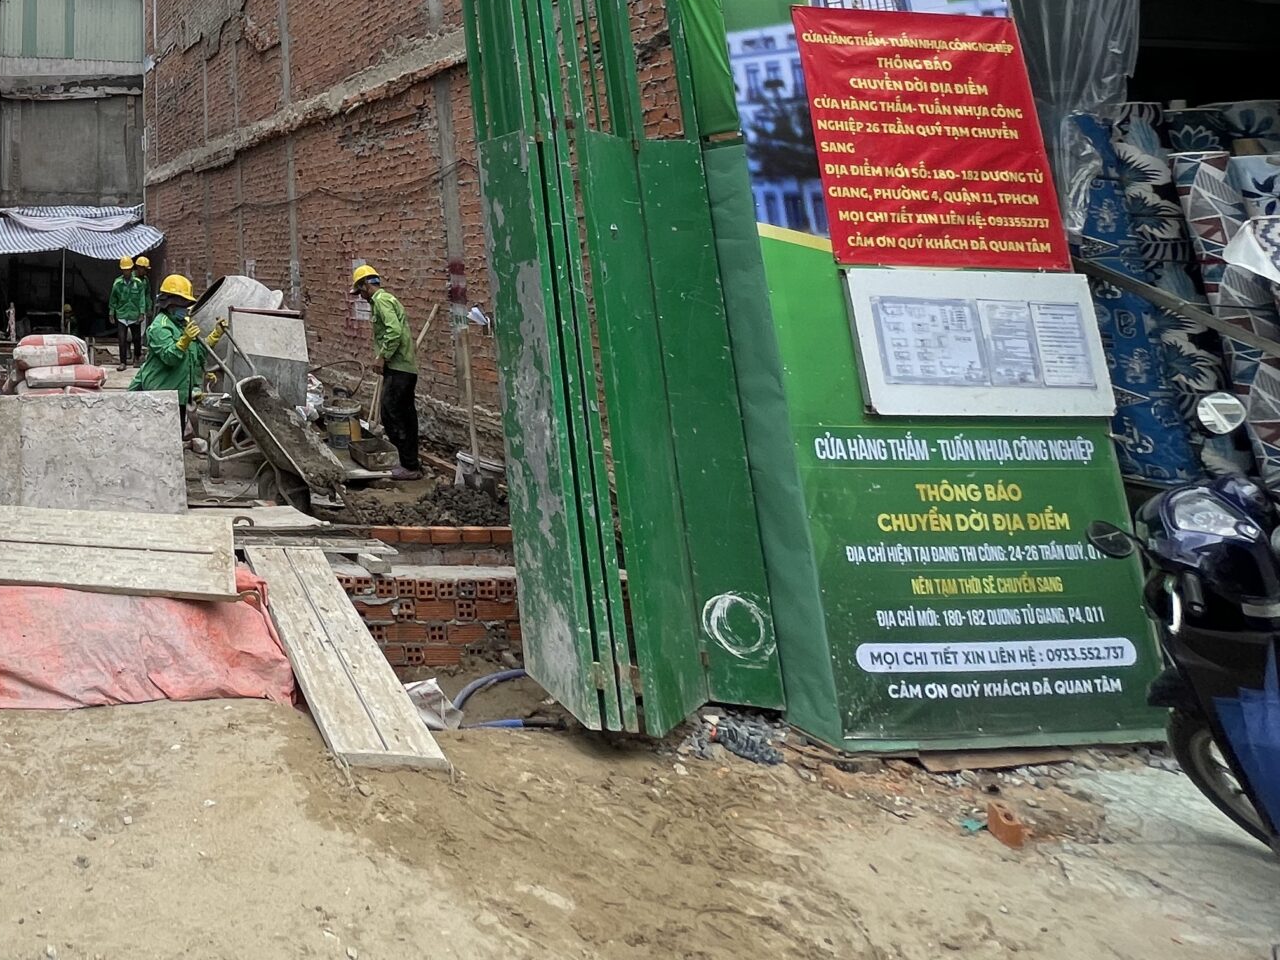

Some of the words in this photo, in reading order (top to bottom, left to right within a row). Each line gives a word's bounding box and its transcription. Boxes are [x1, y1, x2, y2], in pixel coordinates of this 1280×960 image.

[876, 54, 923, 71] THÔNG
[923, 56, 953, 72] BÁO
[849, 72, 903, 92] CHUYỂN
[930, 82, 953, 97] ĐỊA
[954, 76, 989, 96] ĐIỂM
[841, 95, 878, 111] HÀNG
[990, 103, 1023, 119] CÔNG
[865, 123, 880, 133] 26
[881, 117, 915, 135] TRẦN
[820, 141, 856, 154] SANG
[943, 188, 981, 206] QUẬN
[997, 193, 1039, 205] TPHCM
[865, 211, 888, 223] CHI
[915, 213, 938, 224] XIN
[925, 234, 969, 250] KHÁCH
[989, 240, 1026, 253] QUAN
[1026, 238, 1051, 253] TÂM
[814, 432, 847, 460] CỬA
[848, 434, 888, 461] HÀNG
[937, 433, 975, 461] TUẤN
[1014, 435, 1050, 461] CÔNG
[915, 480, 982, 502] THÔNG
[984, 479, 1022, 501] BÁO
[877, 506, 953, 532] CHUYỂN
[954, 509, 990, 532] DỜI
[992, 513, 1025, 536] ĐỊA
[1026, 505, 1071, 530] ĐIỂM
[870, 650, 900, 670] MỌI
[902, 650, 929, 666] CHI
[930, 645, 960, 666] TIẾT
[962, 650, 985, 665] XIN
[989, 647, 1016, 664] LIÊN
[1019, 645, 1037, 667] HỆ
[1046, 645, 1125, 663] 0933.552.737
[888, 680, 923, 699] CẢM
[924, 681, 950, 699] ƠN
[983, 678, 1030, 698] KHÁCH
[1031, 679, 1053, 696] ĐÃ
[1054, 680, 1093, 697] QUAN
[1094, 675, 1122, 693] TÂM
